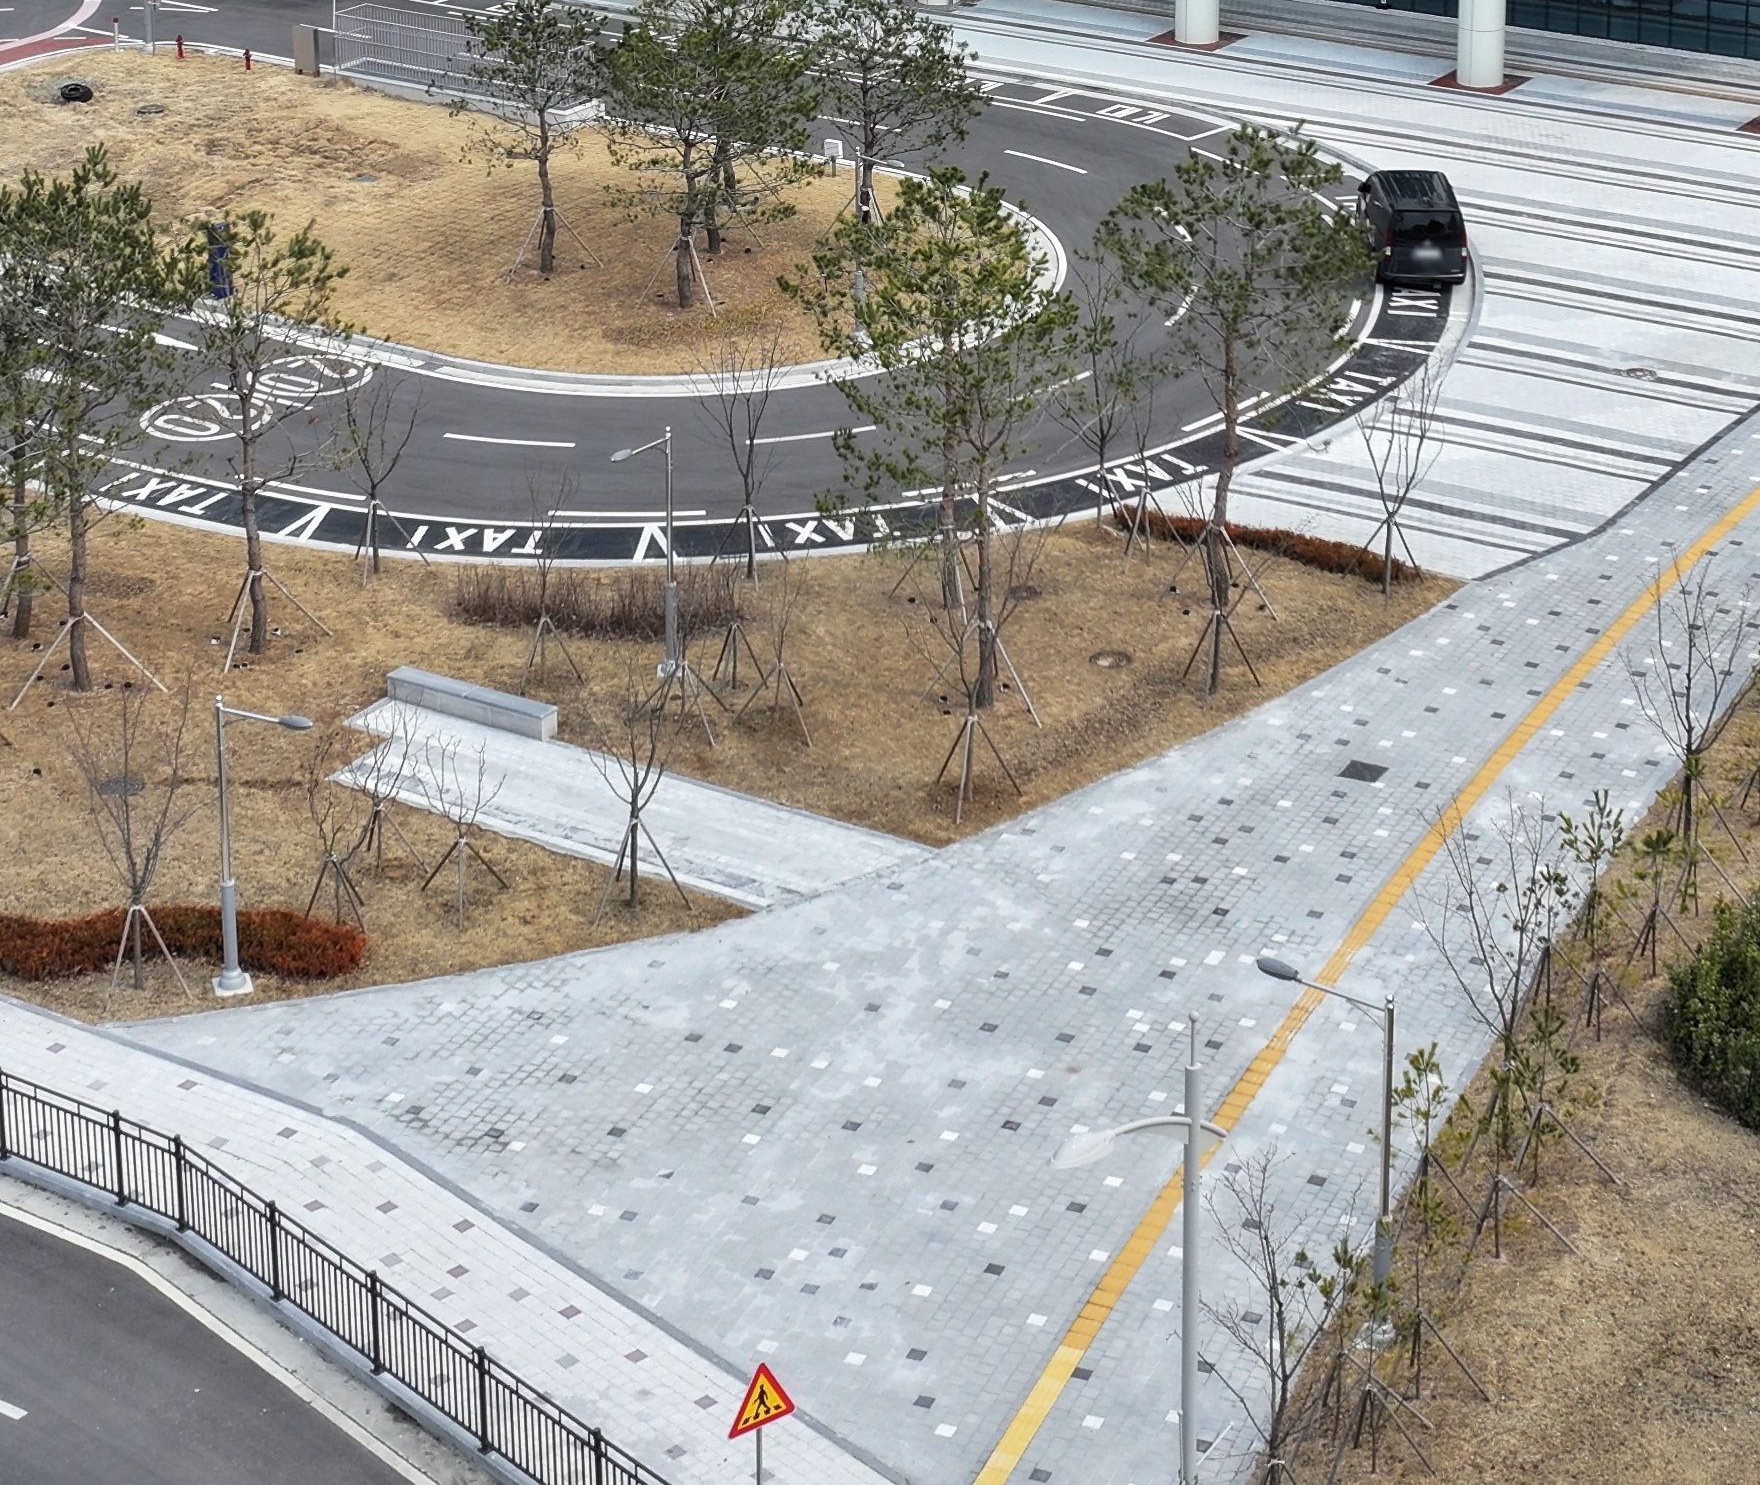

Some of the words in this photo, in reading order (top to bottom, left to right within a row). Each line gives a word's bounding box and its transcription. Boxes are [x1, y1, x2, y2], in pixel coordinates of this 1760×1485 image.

[1095, 103, 1171, 123] 대기
[1387, 287, 1441, 317] AXI
[1295, 371, 1397, 413] TAXI
[1074, 453, 1209, 498] TAXI
[99, 472, 231, 515] TAXI
[405, 525, 542, 554] TAXI
[758, 513, 901, 547] TAXI
